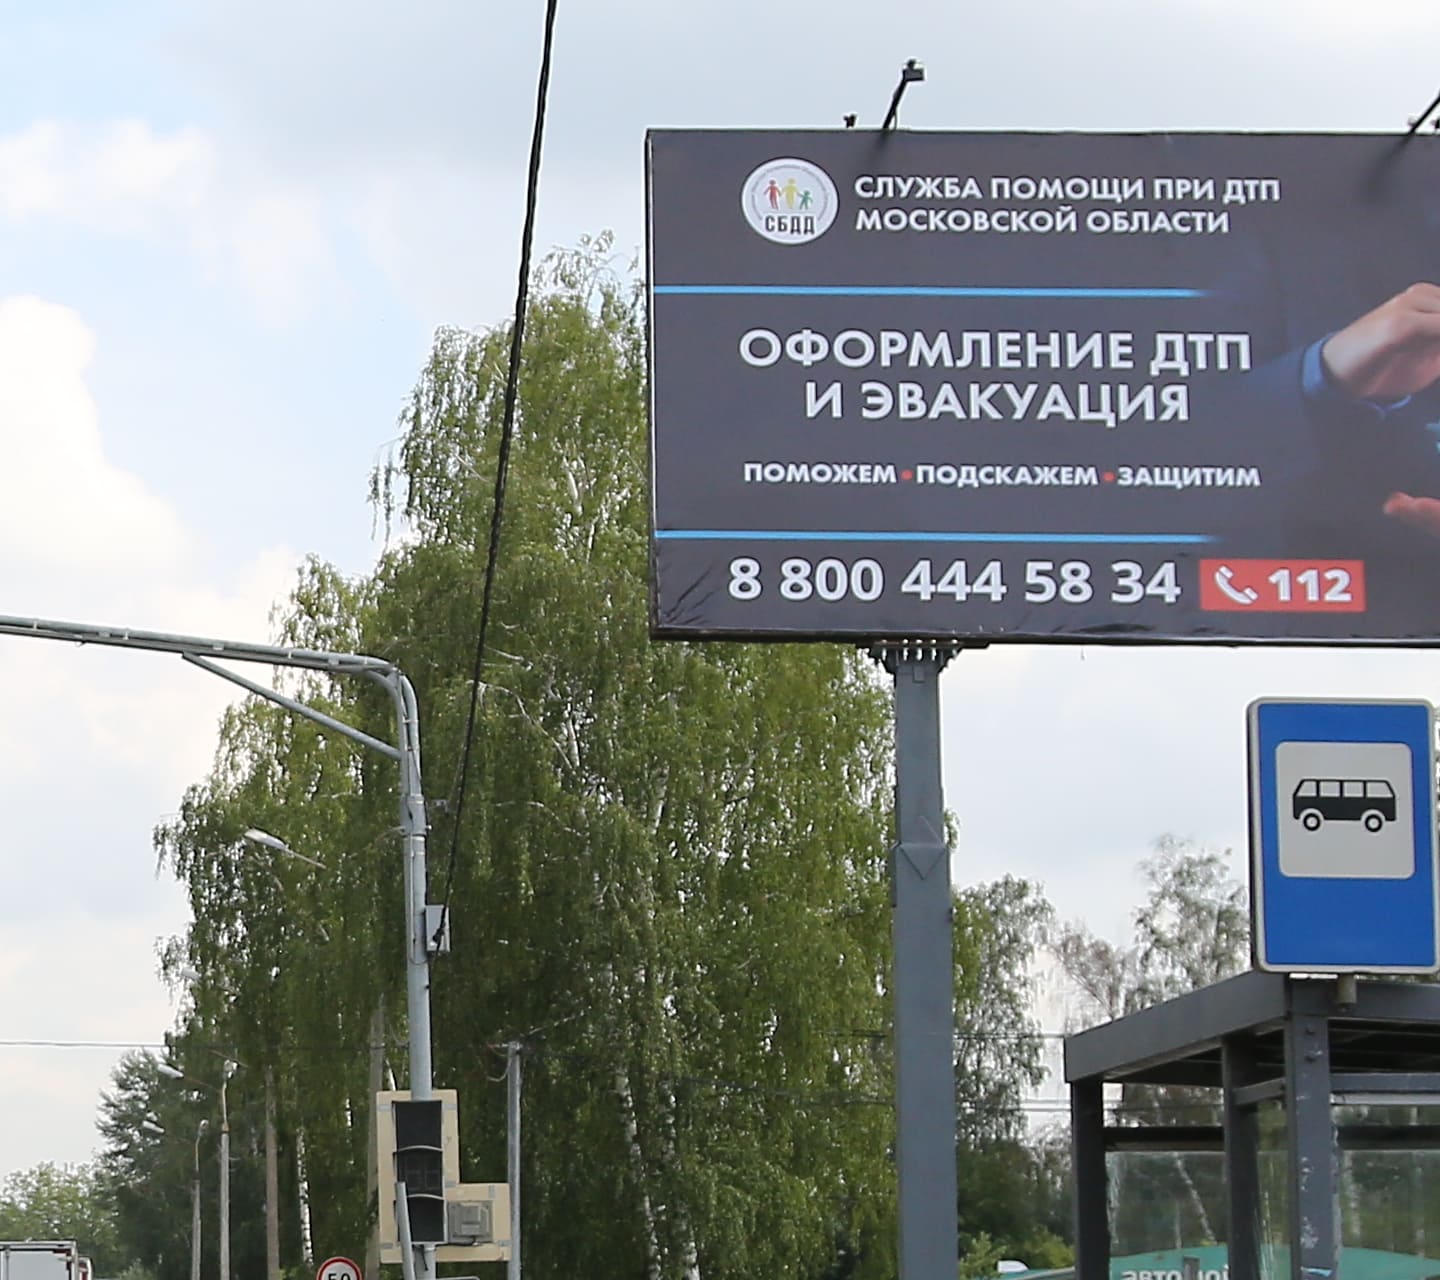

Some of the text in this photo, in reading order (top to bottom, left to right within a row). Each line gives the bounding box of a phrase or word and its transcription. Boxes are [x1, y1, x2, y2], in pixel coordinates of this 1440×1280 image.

[854, 176, 983, 199] СЛУЖБА
[990, 177, 1145, 203] ПОМОЩИ
[1153, 178, 1216, 200] ПРИ
[1223, 179, 1280, 204] ДТП
[764, 215, 816, 236] СБДД
[855, 206, 1230, 233] МОСКОВСКОЙ ОБЛАСТИ
[738, 328, 1252, 377] ОФОРМЛЕНИЕ ДТП
[804, 382, 1190, 428] И ЭВАКУАЦИЯ
[743, 463, 1260, 489] ПОМОЖЕМ ПОДСКАЖЕМ ЗАЩИТИМ
[728, 557, 1182, 603] 8 800 444 58 34
[1269, 567, 1354, 602] 112
